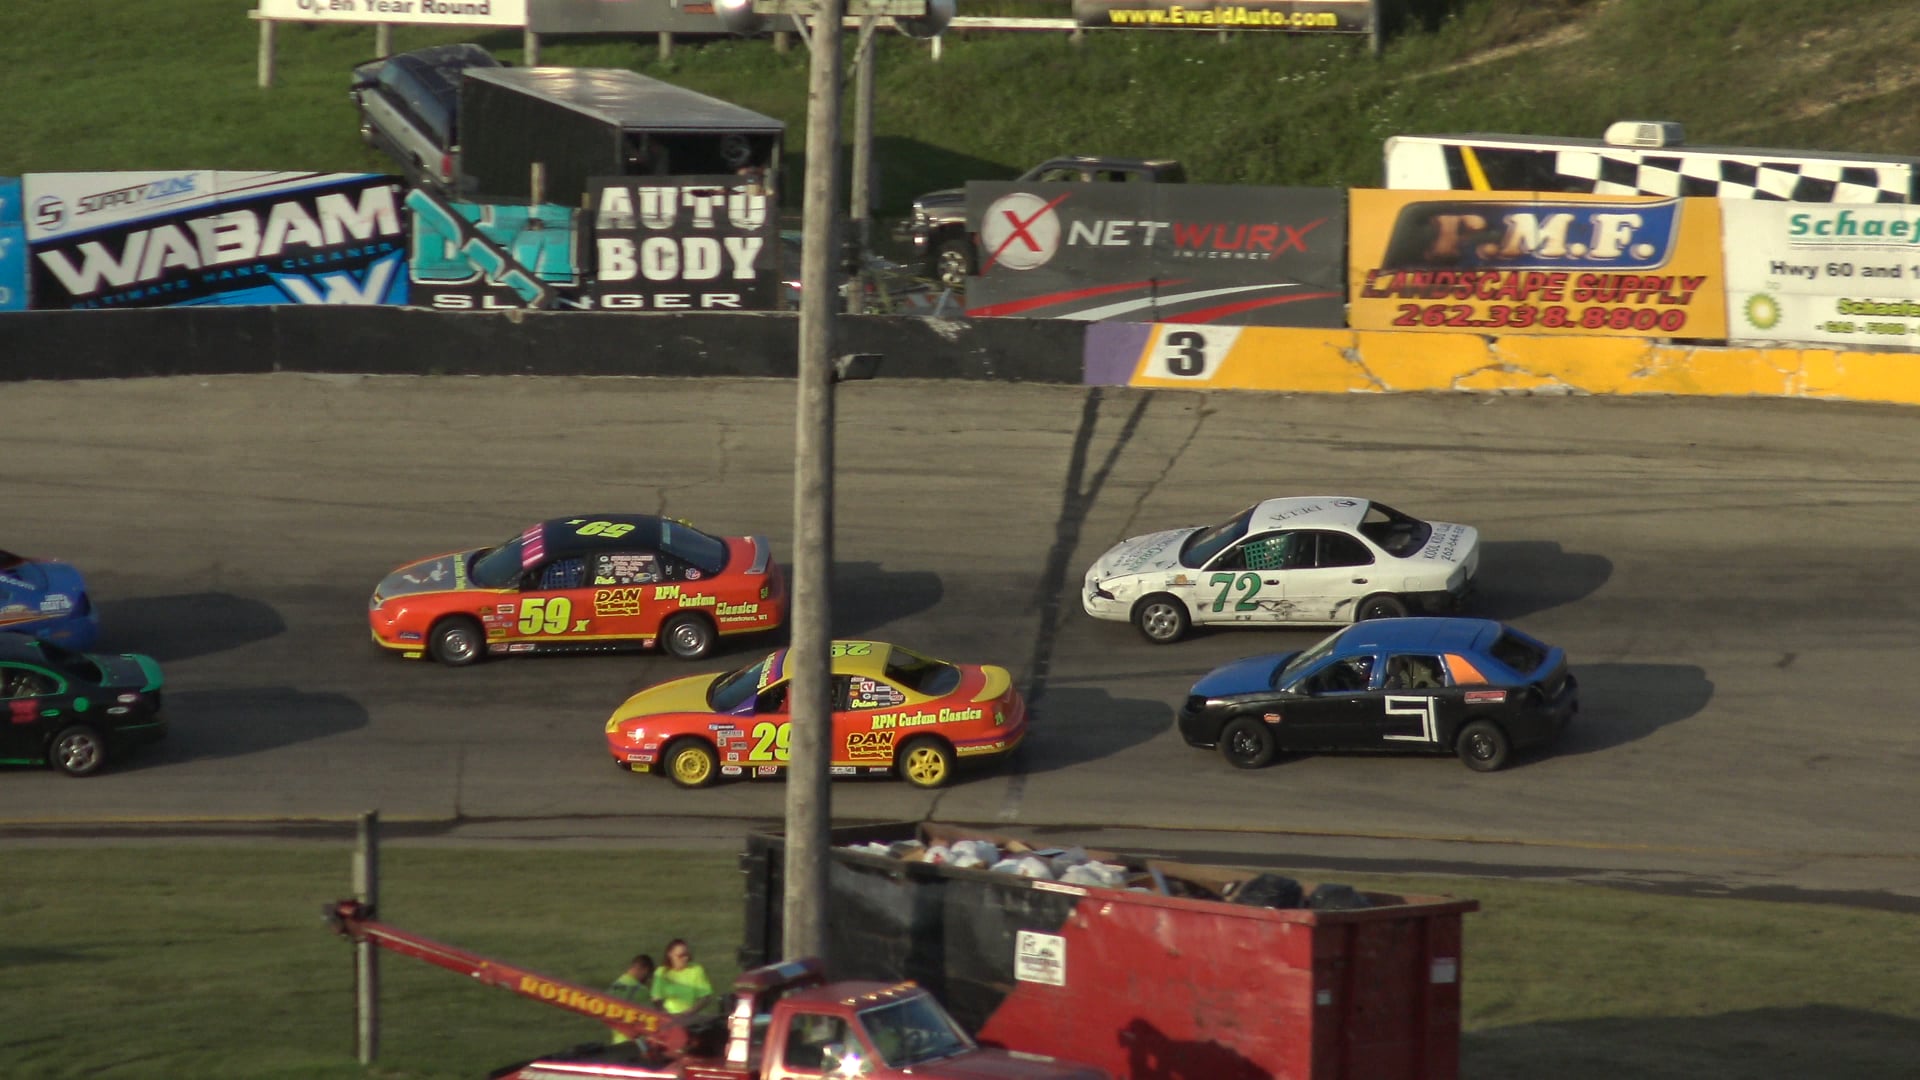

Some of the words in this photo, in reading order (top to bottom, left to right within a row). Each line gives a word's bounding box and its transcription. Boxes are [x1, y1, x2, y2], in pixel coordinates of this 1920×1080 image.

[365, 0, 413, 12] Year
[421, 0, 491, 15] Round
[1109, 6, 1338, 27] www.EwaldAuto.com
[596, 186, 765, 230] AUTO
[37, 184, 401, 296] WABAM
[597, 237, 764, 281] BODY
[1067, 218, 1329, 262] NETWURX
[1173, 250, 1271, 261] INTERNET
[203, 263, 269, 283] HAND
[282, 242, 394, 270] CLEANER
[1769, 260, 1819, 280] Hwy
[1827, 262, 1854, 277] 60
[1861, 264, 1902, 279] and
[1361, 268, 1566, 301] LANDSCAPE
[1573, 275, 1707, 306] SUPPLY
[1392, 303, 1687, 332] 262.338.8800
[1166, 331, 1205, 376] 3
[595, 588, 642, 603] DAN
[654, 585, 680, 601] RPM
[679, 592, 716, 608] Custom
[716, 601, 759, 616] Classics
[1209, 572, 1262, 613] 72
[518, 597, 572, 635] 59
[871, 713, 897, 729] RPM
[899, 710, 937, 727] Custom
[939, 707, 982, 723] Classics
[748, 721, 792, 761] 29
[847, 731, 896, 746] DAN
